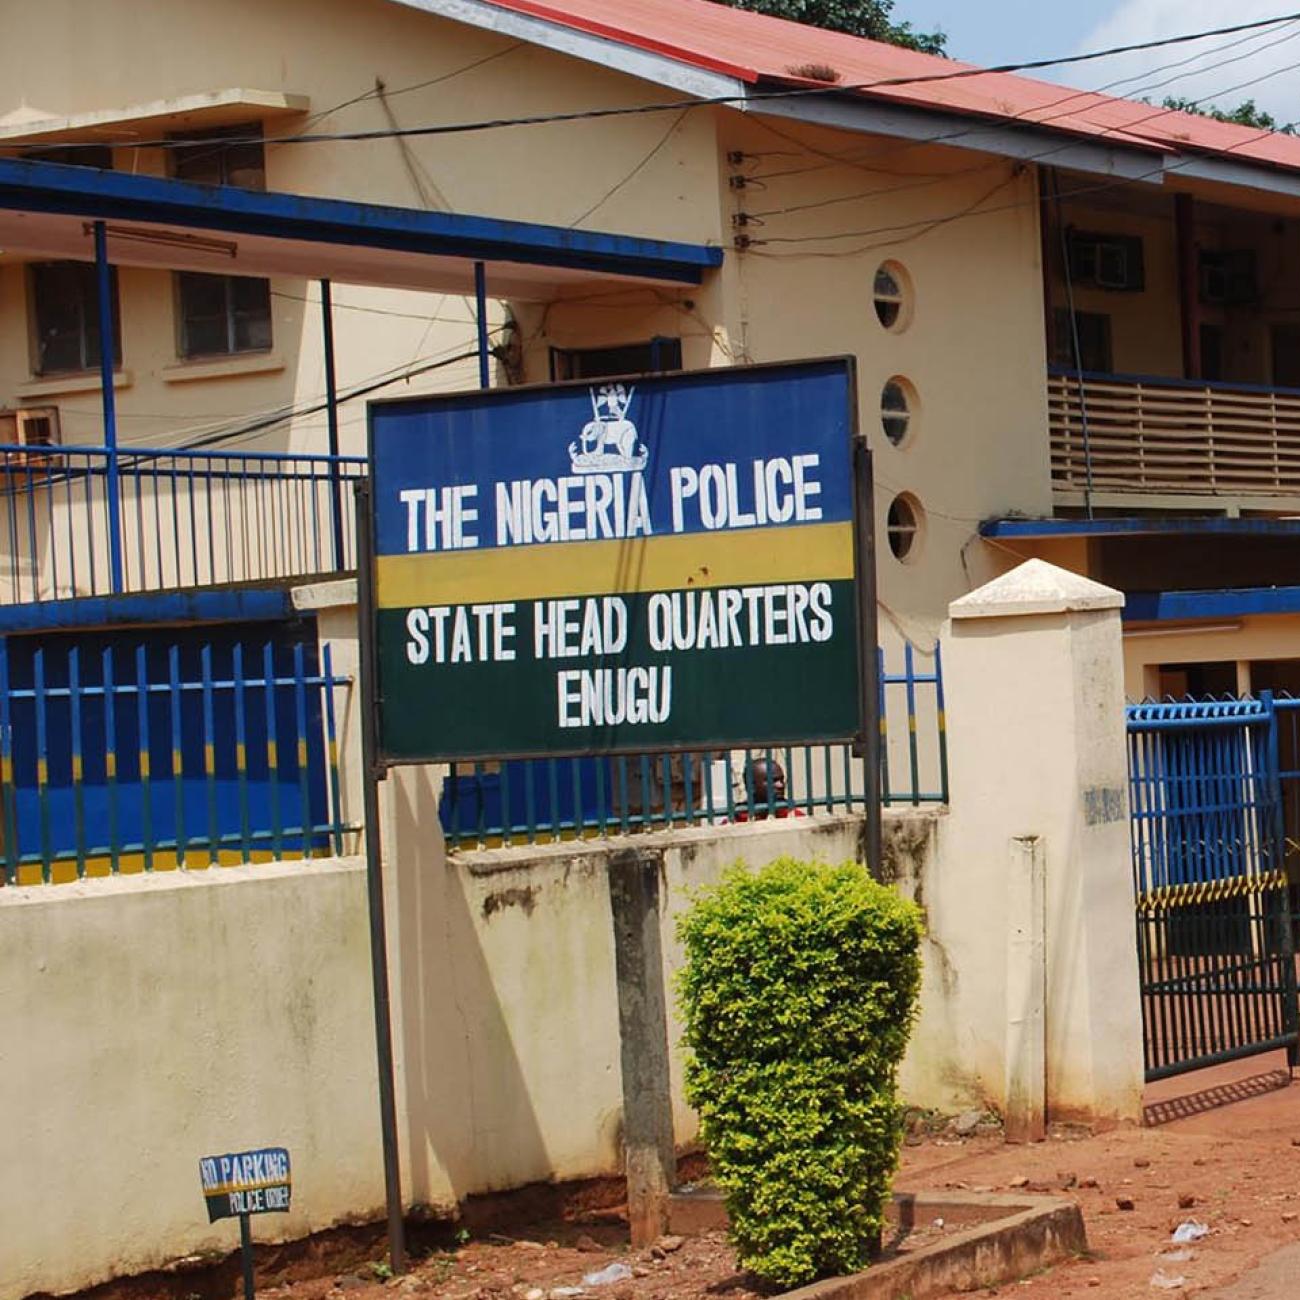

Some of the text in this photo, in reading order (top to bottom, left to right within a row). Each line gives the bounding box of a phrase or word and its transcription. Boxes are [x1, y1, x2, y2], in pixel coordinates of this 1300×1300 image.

[400, 454, 823, 551] THE NIGERIA POLICE
[406, 583, 833, 664] STATE HEAD QUARTERS
[558, 666, 671, 728] ENUGU
[201, 1153, 288, 1190] NO PARKING
[229, 1188, 265, 1214] POLICE
